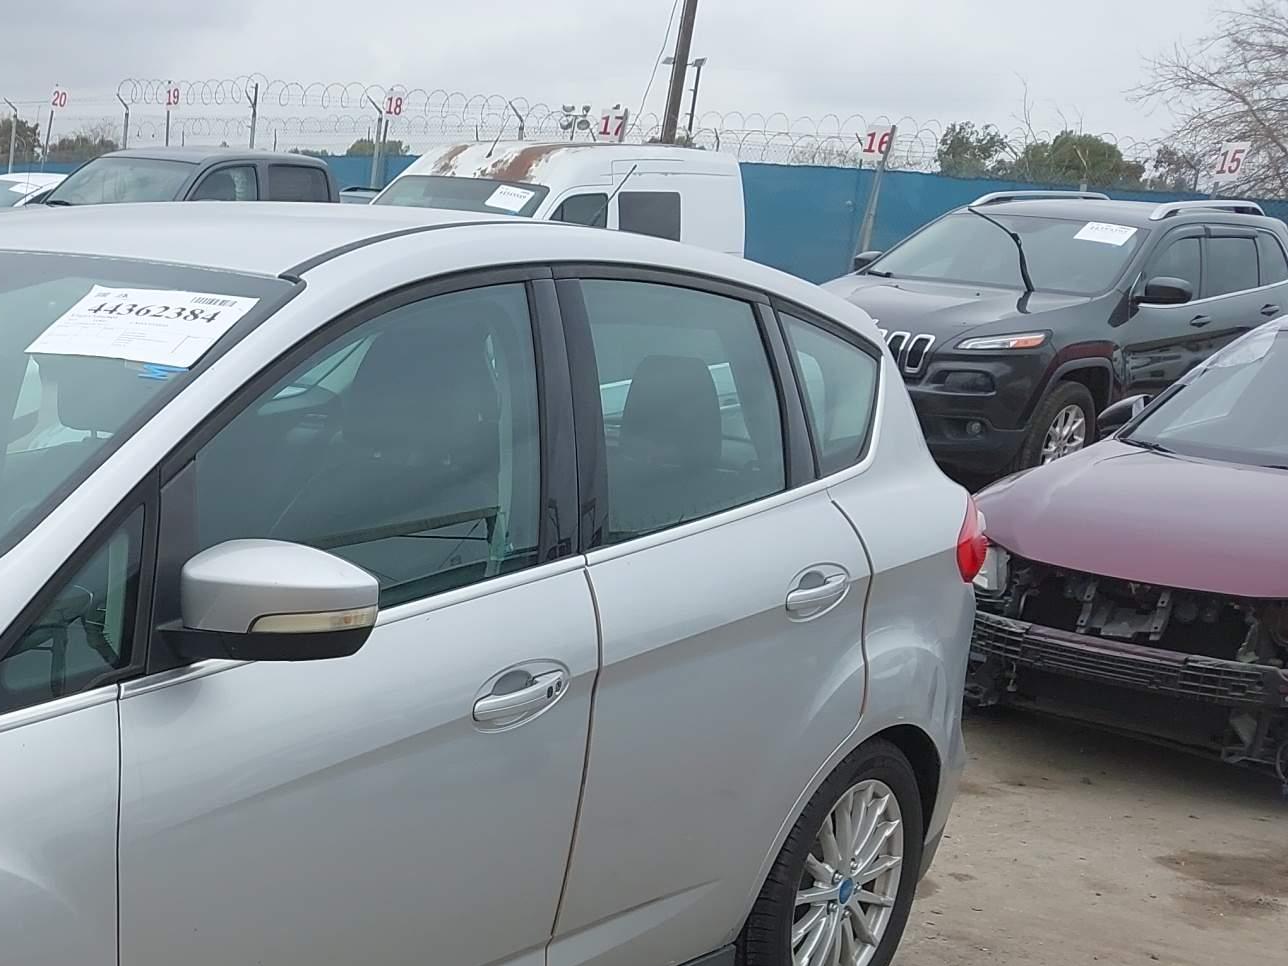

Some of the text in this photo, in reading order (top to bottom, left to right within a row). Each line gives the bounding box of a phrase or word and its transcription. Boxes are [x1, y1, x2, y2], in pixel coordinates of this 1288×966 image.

[51, 90, 67, 108] 20
[166, 88, 180, 106] 19
[385, 96, 403, 116] 18
[598, 115, 626, 137] 17
[1215, 149, 1246, 174] 15
[88, 302, 222, 324] 44362384
